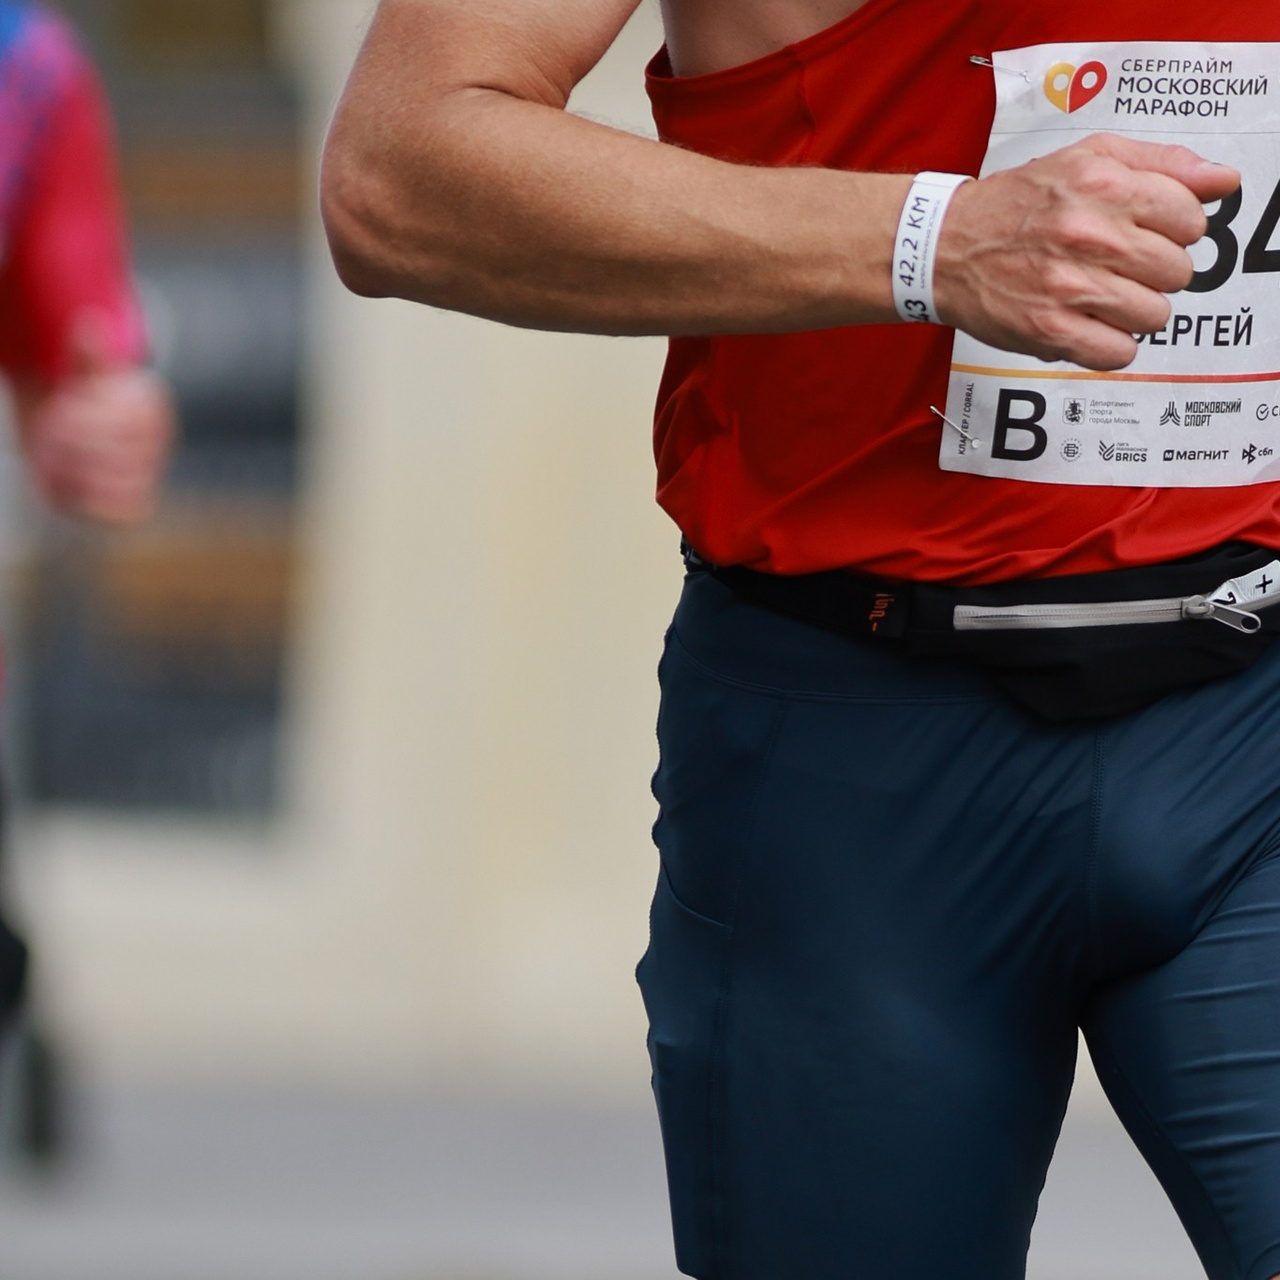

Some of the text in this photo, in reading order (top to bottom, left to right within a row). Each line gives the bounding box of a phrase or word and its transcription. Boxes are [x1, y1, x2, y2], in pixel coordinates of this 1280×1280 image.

[1120, 58, 1233, 74] СБЕРПРАЙМ
[1116, 75, 1269, 96] МОСКОВСКИЙ
[1113, 97, 1229, 117] МАРАФОН
[898, 237, 919, 287] 42,2
[963, 382, 975, 413] CORRAL
[1184, 398, 1242, 414] МОСКОВСКИЙ
[1184, 414, 1212, 427] СПОРТ
[1115, 452, 1148, 462] BRICS
